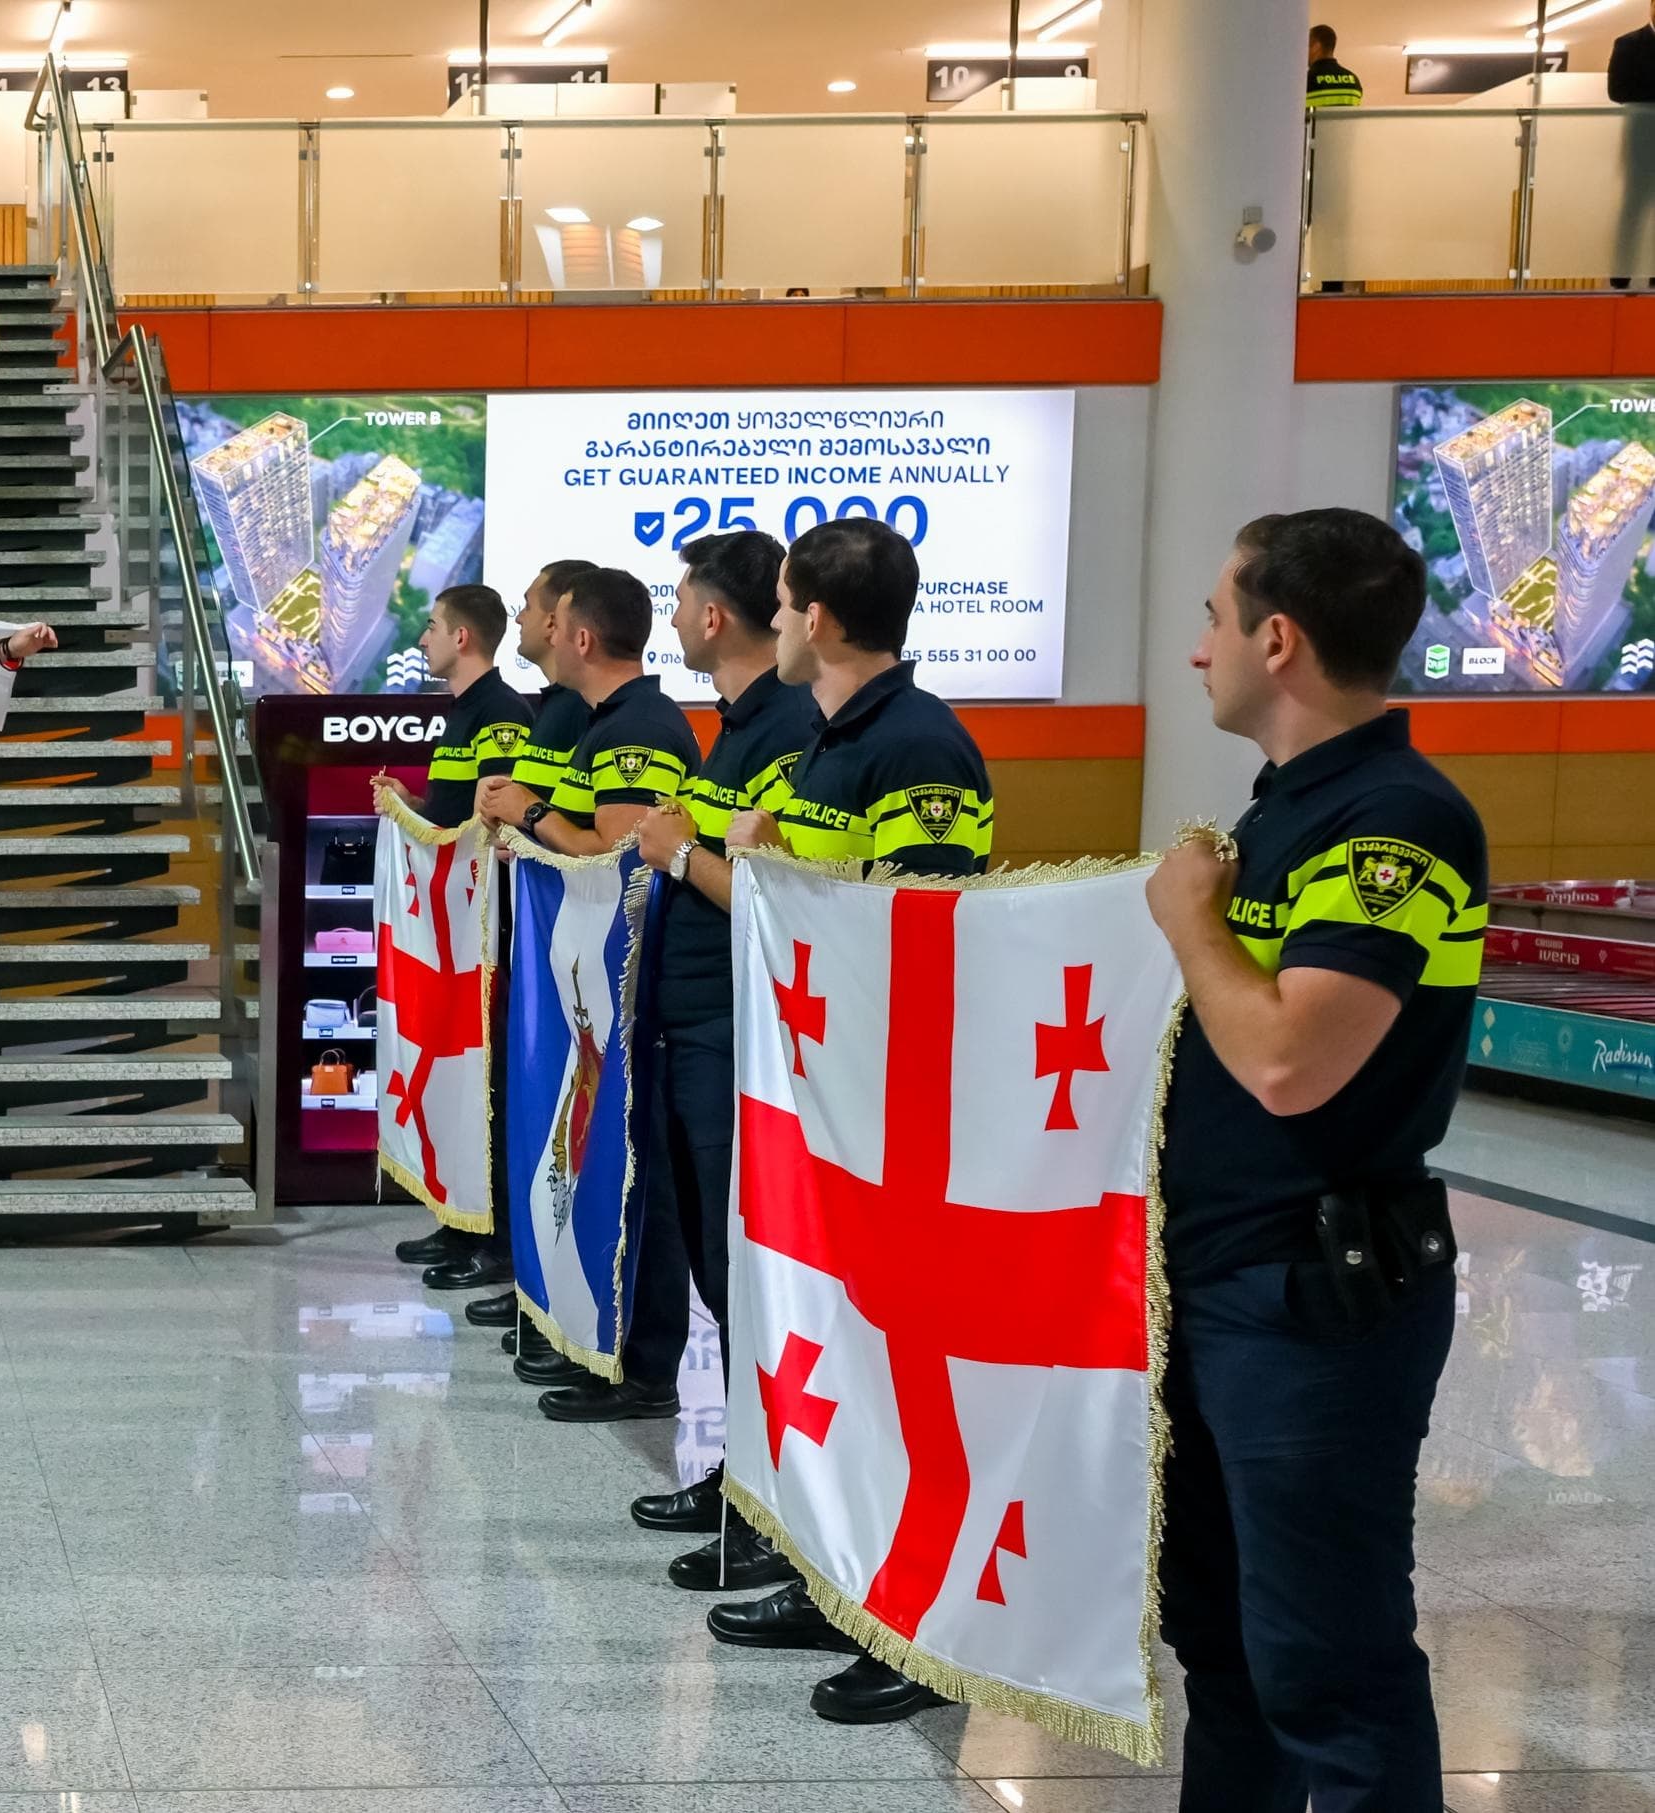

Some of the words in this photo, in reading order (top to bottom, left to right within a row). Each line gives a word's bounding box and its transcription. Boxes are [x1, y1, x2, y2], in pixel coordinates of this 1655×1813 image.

[935, 65, 970, 89] 10
[1316, 74, 1356, 85] POLICE
[364, 411, 427, 426] TOWER
[429, 411, 442, 426] B
[626, 411, 731, 431] მიიღეთ
[819, 436, 992, 457] შემოსავალი
[563, 468, 612, 487] GET
[618, 466, 780, 487] GUARANTEED
[787, 466, 882, 486] INCOME
[889, 464, 1011, 485] ANNUALLY
[914, 600, 925, 614] A
[930, 600, 985, 614] HOTEL
[990, 599, 1044, 613] ROOM
[927, 649, 960, 662] 555
[964, 649, 982, 662] 31
[986, 649, 1010, 662] 00
[1014, 648, 1037, 662] 00
[800, 800, 850, 830] POLICE
[1592, 1037, 1653, 1073] Radisson
